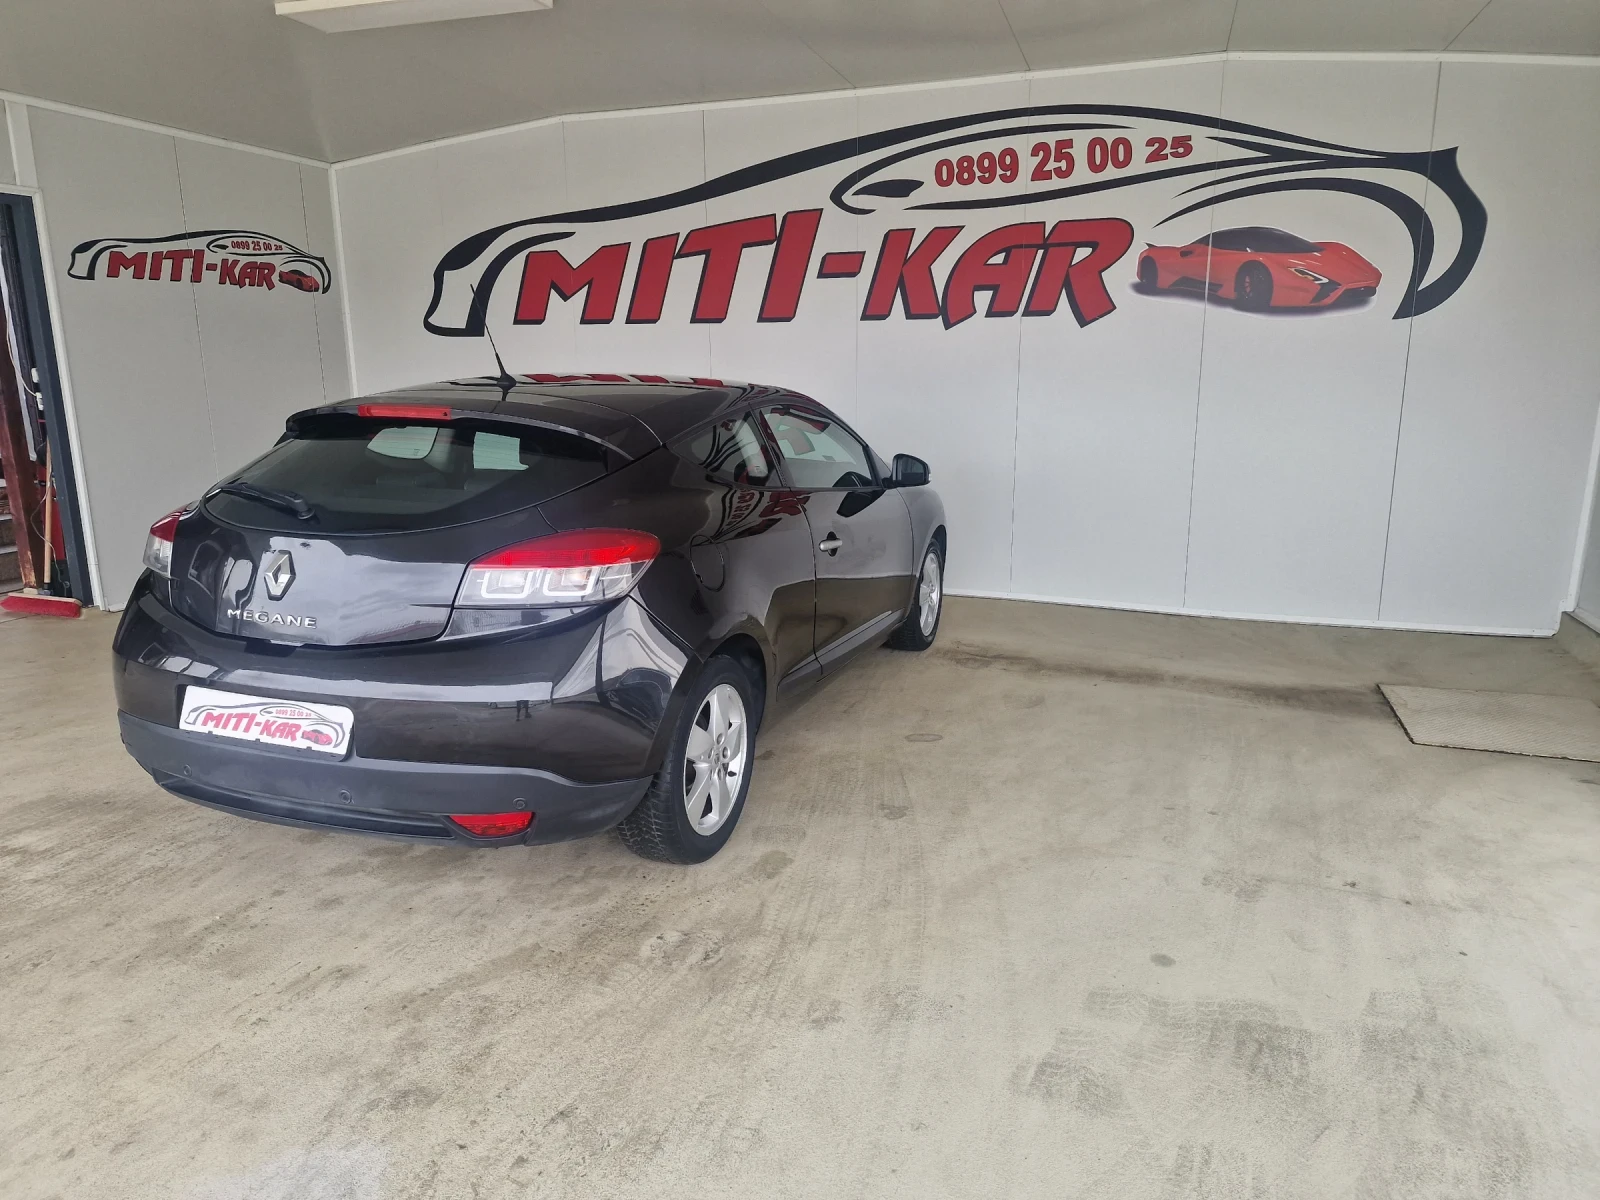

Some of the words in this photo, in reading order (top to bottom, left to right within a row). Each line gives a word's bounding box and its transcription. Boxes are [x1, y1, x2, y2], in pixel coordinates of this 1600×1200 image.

[934, 147, 1019, 187] 0899
[1030, 138, 1075, 181] 25
[1087, 136, 1132, 173] 00
[1145, 135, 1193, 163] 25
[231, 240, 250, 250] 0899
[251, 240, 262, 251] 25
[262, 242, 273, 251] 00
[106, 249, 276, 291] MITI-KAR
[513, 208, 1134, 329] MITI-KAR
[226, 608, 318, 629] MEGANE
[201, 711, 302, 742] MITI-KAR
